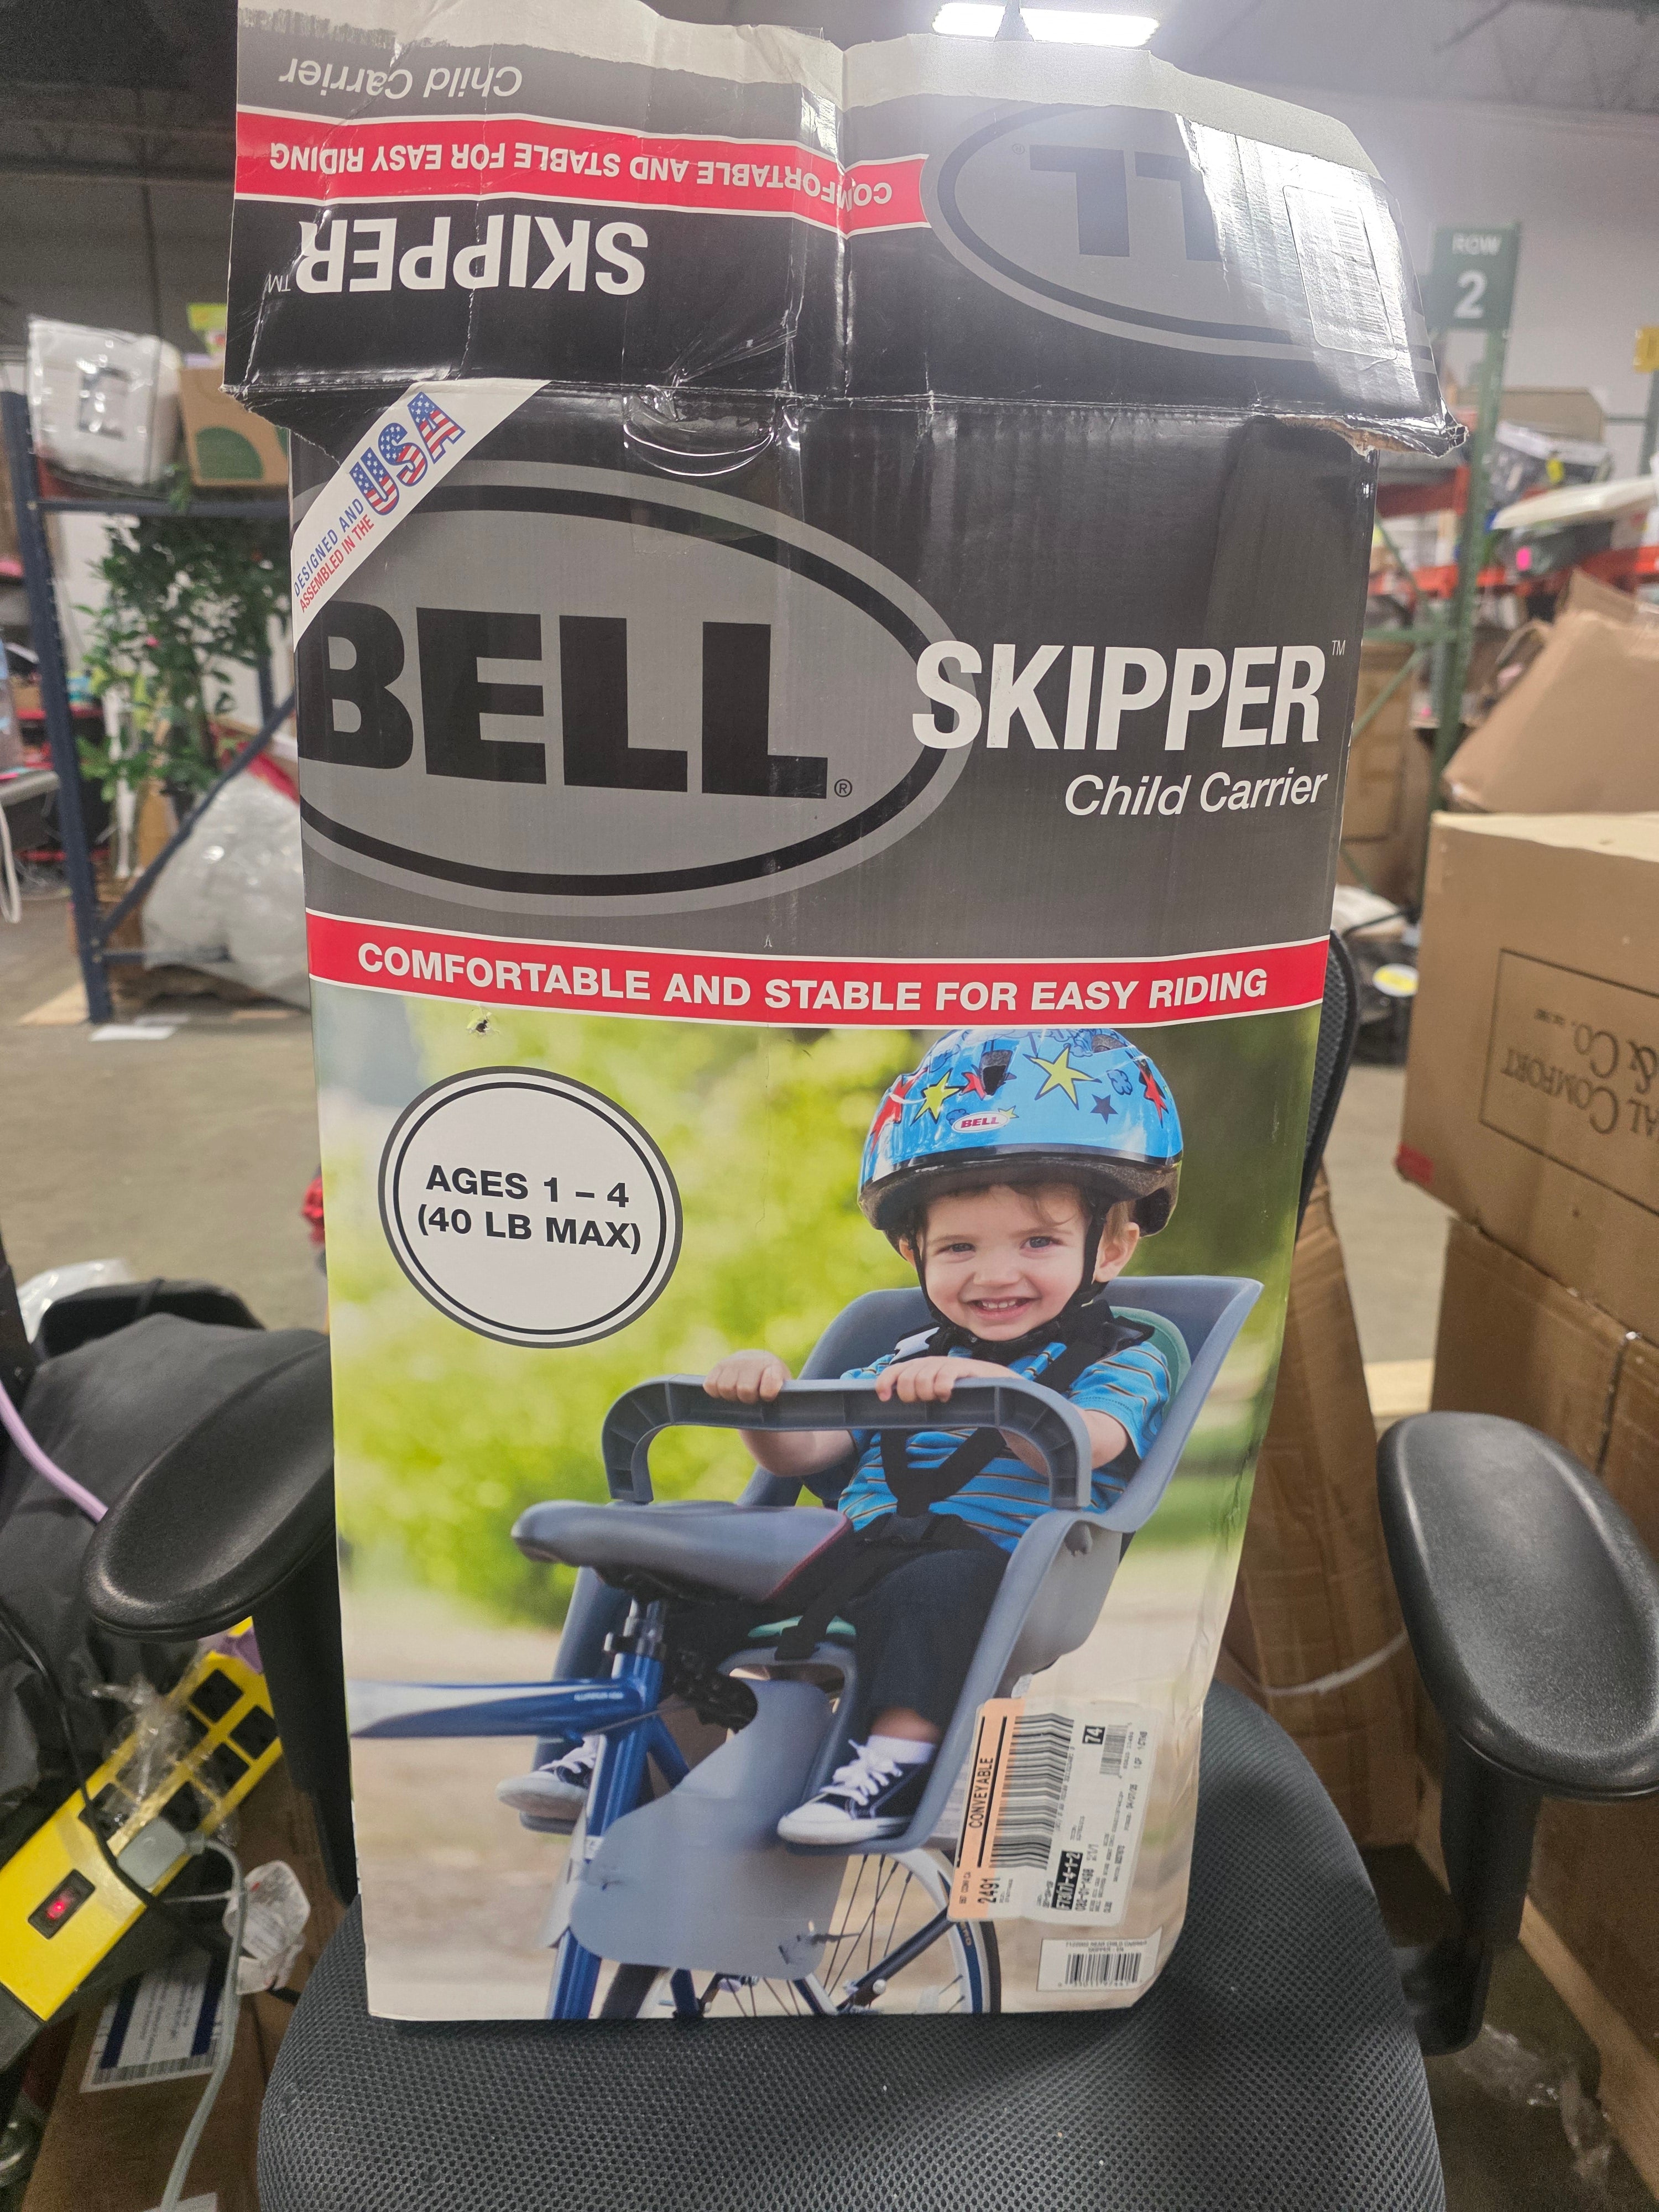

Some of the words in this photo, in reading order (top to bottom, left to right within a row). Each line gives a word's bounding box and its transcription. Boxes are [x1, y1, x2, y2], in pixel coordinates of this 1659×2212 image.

[279, 58, 413, 100] Carrier
[423, 64, 523, 98] Child
[270, 142, 365, 174] RIDING
[371, 144, 442, 173] EASY
[451, 142, 505, 170] FOR
[515, 142, 621, 178] STABLE
[630, 154, 690, 184] AND
[697, 161, 893, 212] COMFORTABLE
[296, 215, 649, 296] SKIPPER
[1452, 232, 1502, 256] ROW
[1453, 269, 1488, 319] 2
[349, 392, 466, 516] USA
[294, 529, 338, 597] DESIGNED
[340, 498, 365, 534] AND
[299, 549, 345, 613] ASSEMBLED
[343, 535, 357, 556] IN
[352, 514, 375, 542] THE
[294, 599, 828, 800] BELL
[912, 640, 1326, 750] SKIPPER
[1065, 775, 1190, 816] Child
[1199, 767, 1328, 813] Carrier
[358, 943, 651, 1000] COMFORTABLE
[664, 973, 751, 1006] AND
[765, 979, 921, 1011] STABLE
[935, 982, 1017, 1011] FOR
[1030, 980, 1139, 1011] EASY
[1148, 968, 1268, 1009] RIDING
[961, 1117, 999, 1128] BELL
[426, 1164, 529, 1200] AGES
[544, 1177, 559, 1203] 1
[607, 1182, 629, 1208] 4
[418, 1204, 472, 1236] (40
[485, 1211, 532, 1240] LB
[545, 1217, 641, 1255] MAX)
[1084, 1726, 1103, 1744] 74
[968, 1757, 994, 1828] CONVEYABLE
[977, 1877, 1000, 1903] 2491
